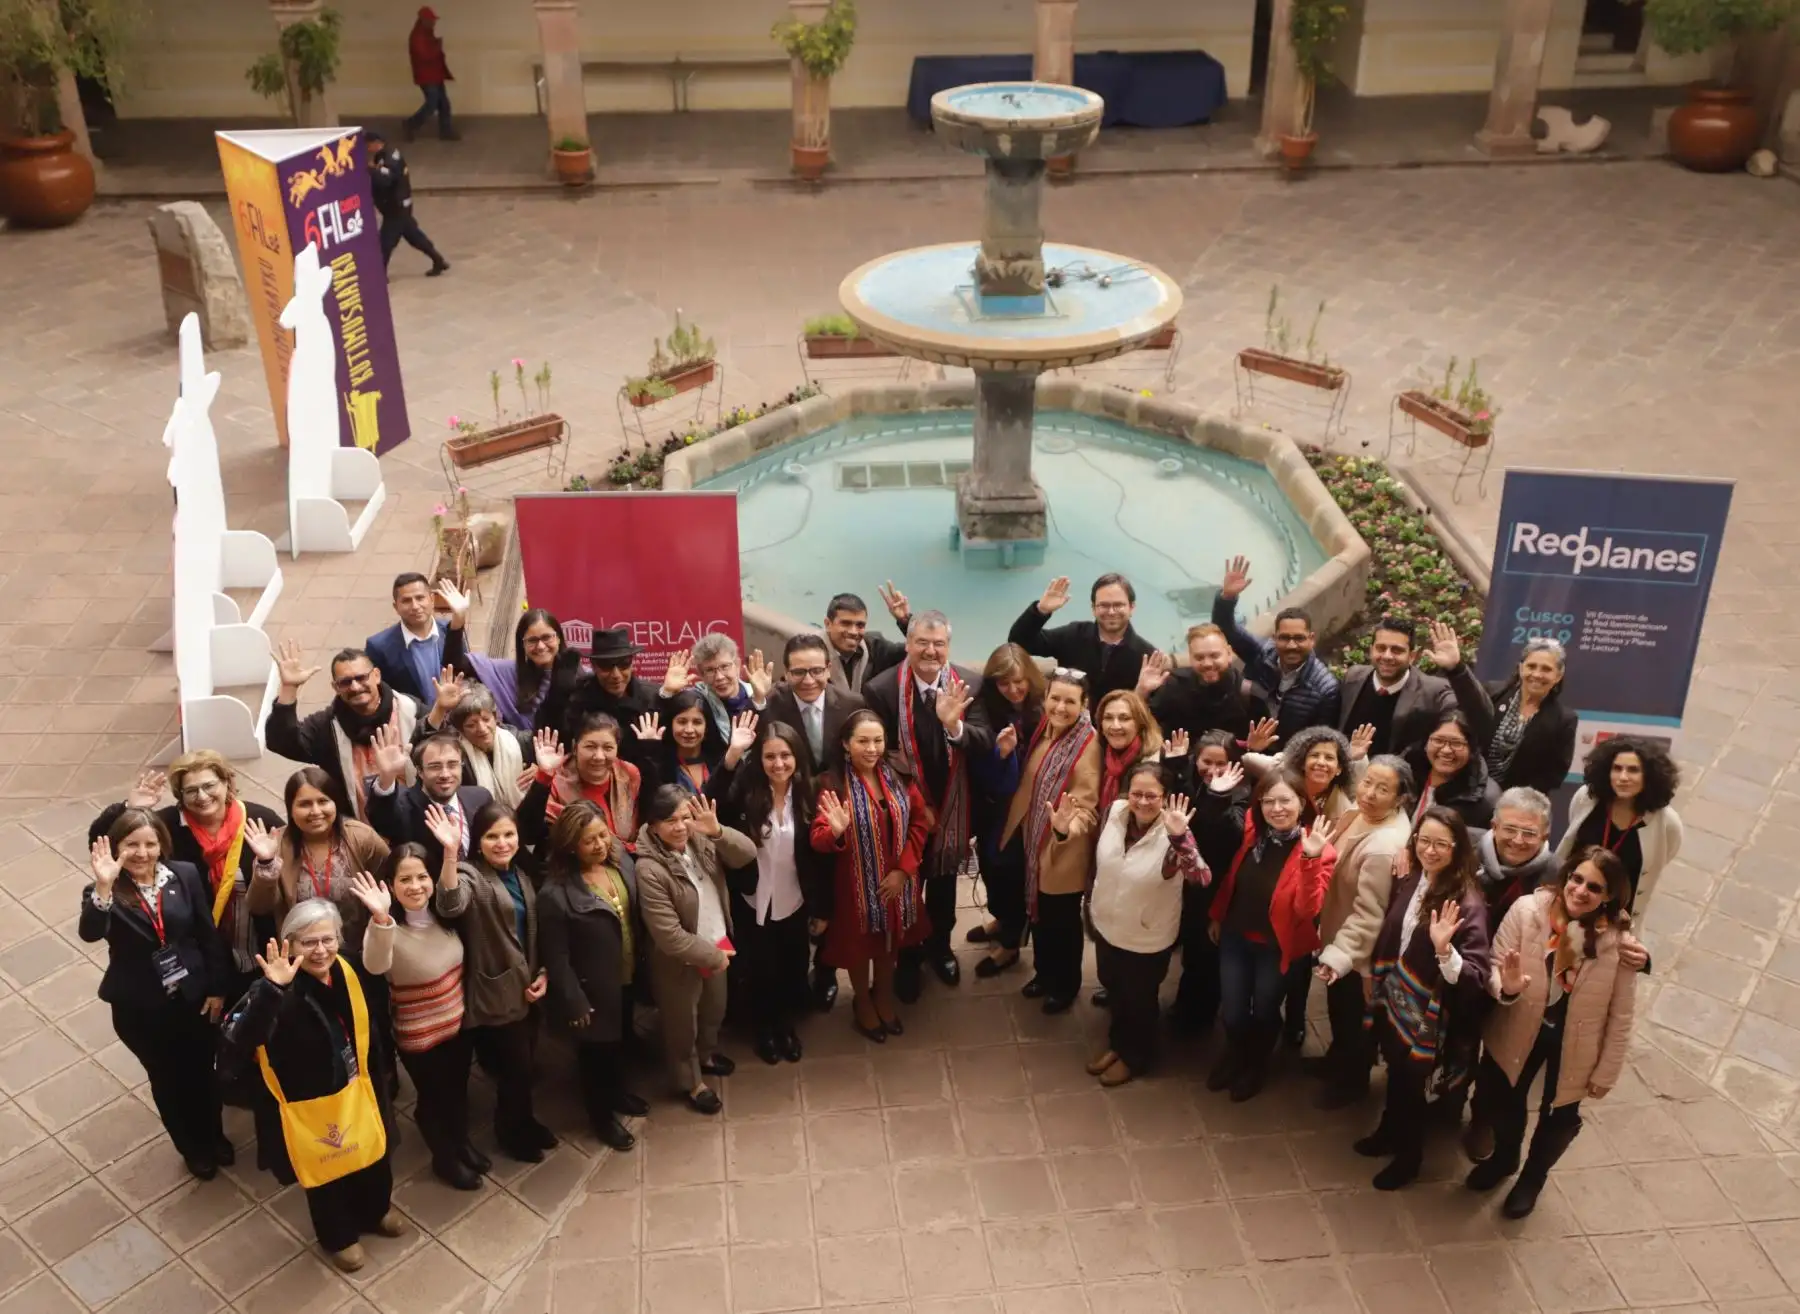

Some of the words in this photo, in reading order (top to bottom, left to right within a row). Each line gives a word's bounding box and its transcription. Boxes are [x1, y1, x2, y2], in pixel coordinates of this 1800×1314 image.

[330, 252, 375, 388] KUTIMUSHAYKU
[1511, 521, 1698, 575] Redplanes
[1515, 606, 1575, 625] Cusco
[1592, 619, 1608, 627] Red
[1597, 611, 1637, 621] Encuentro
[1637, 614, 1649, 622] de
[1511, 625, 1572, 645] 2019
[1631, 637, 1656, 647] Planes
[1591, 643, 1620, 653] Lectura
